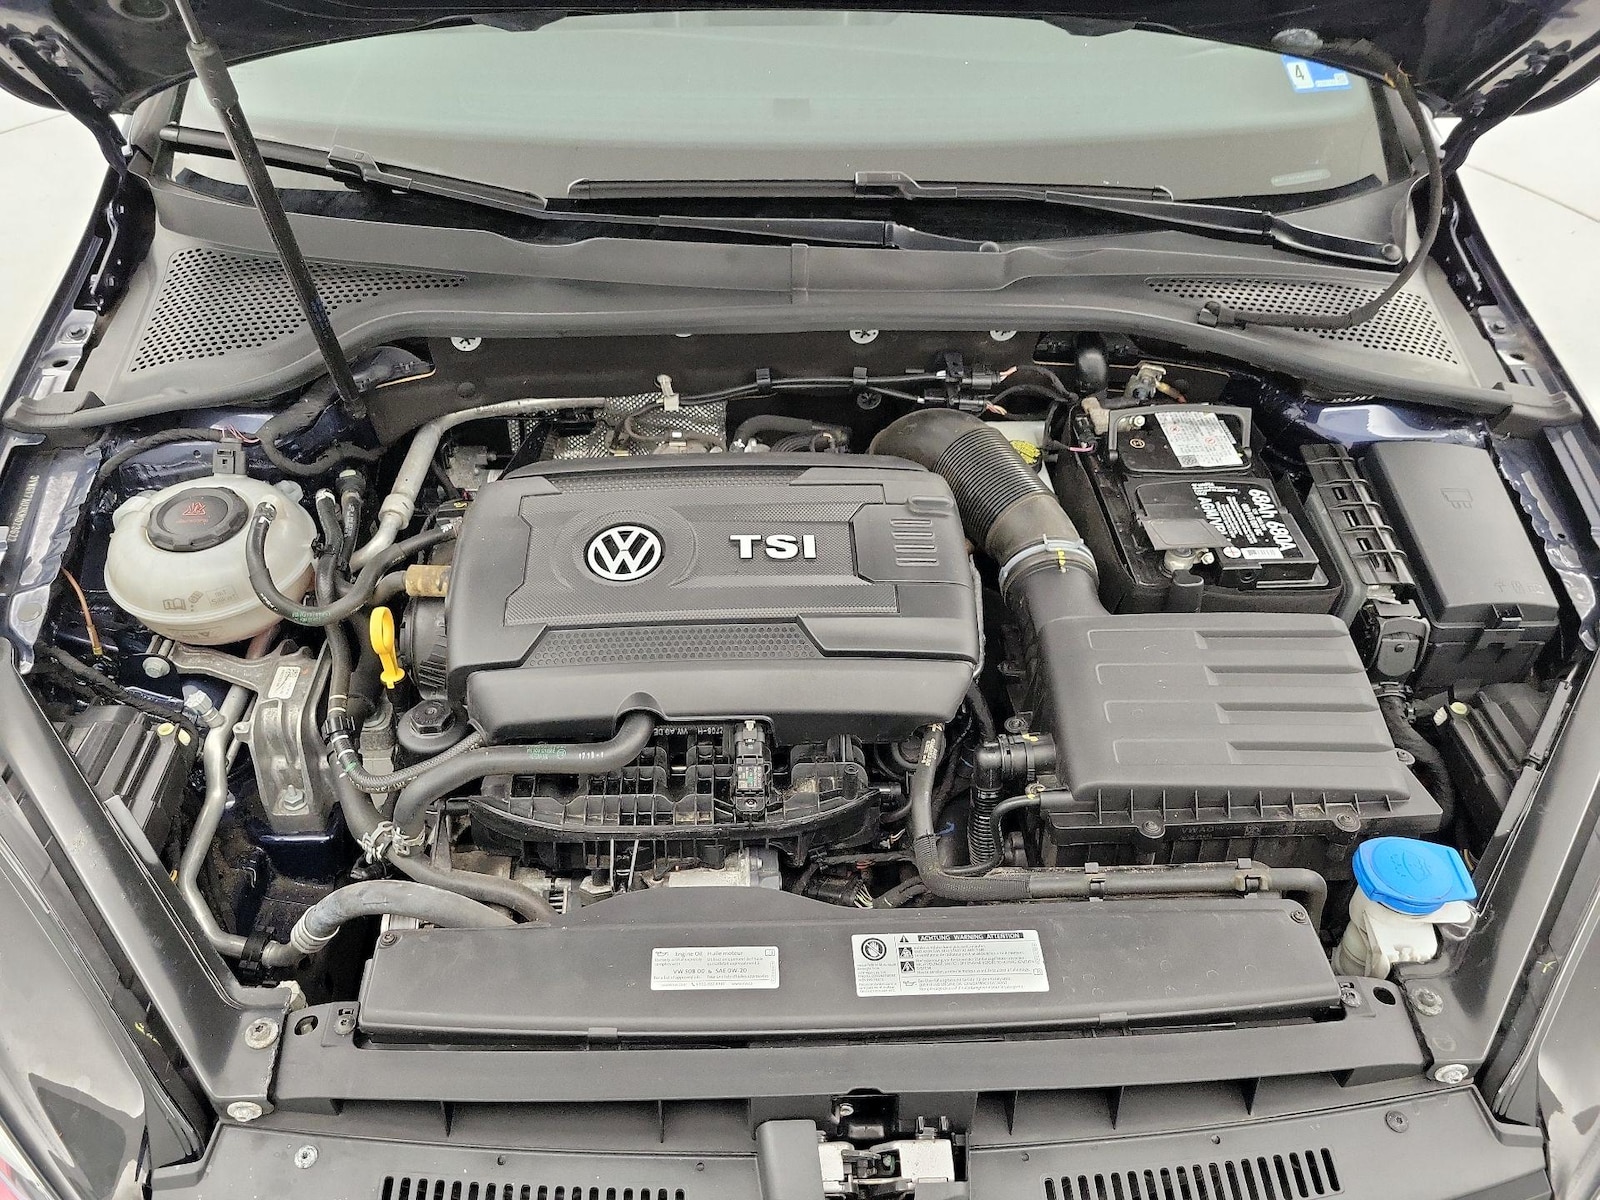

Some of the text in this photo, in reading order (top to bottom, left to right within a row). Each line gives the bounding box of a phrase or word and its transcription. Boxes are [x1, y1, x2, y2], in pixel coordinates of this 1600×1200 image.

[1295, 64, 1305, 80] 4
[1248, 488, 1278, 519] 68Ah
[1265, 520, 1297, 552] 680A
[729, 534, 818, 560] TSI
